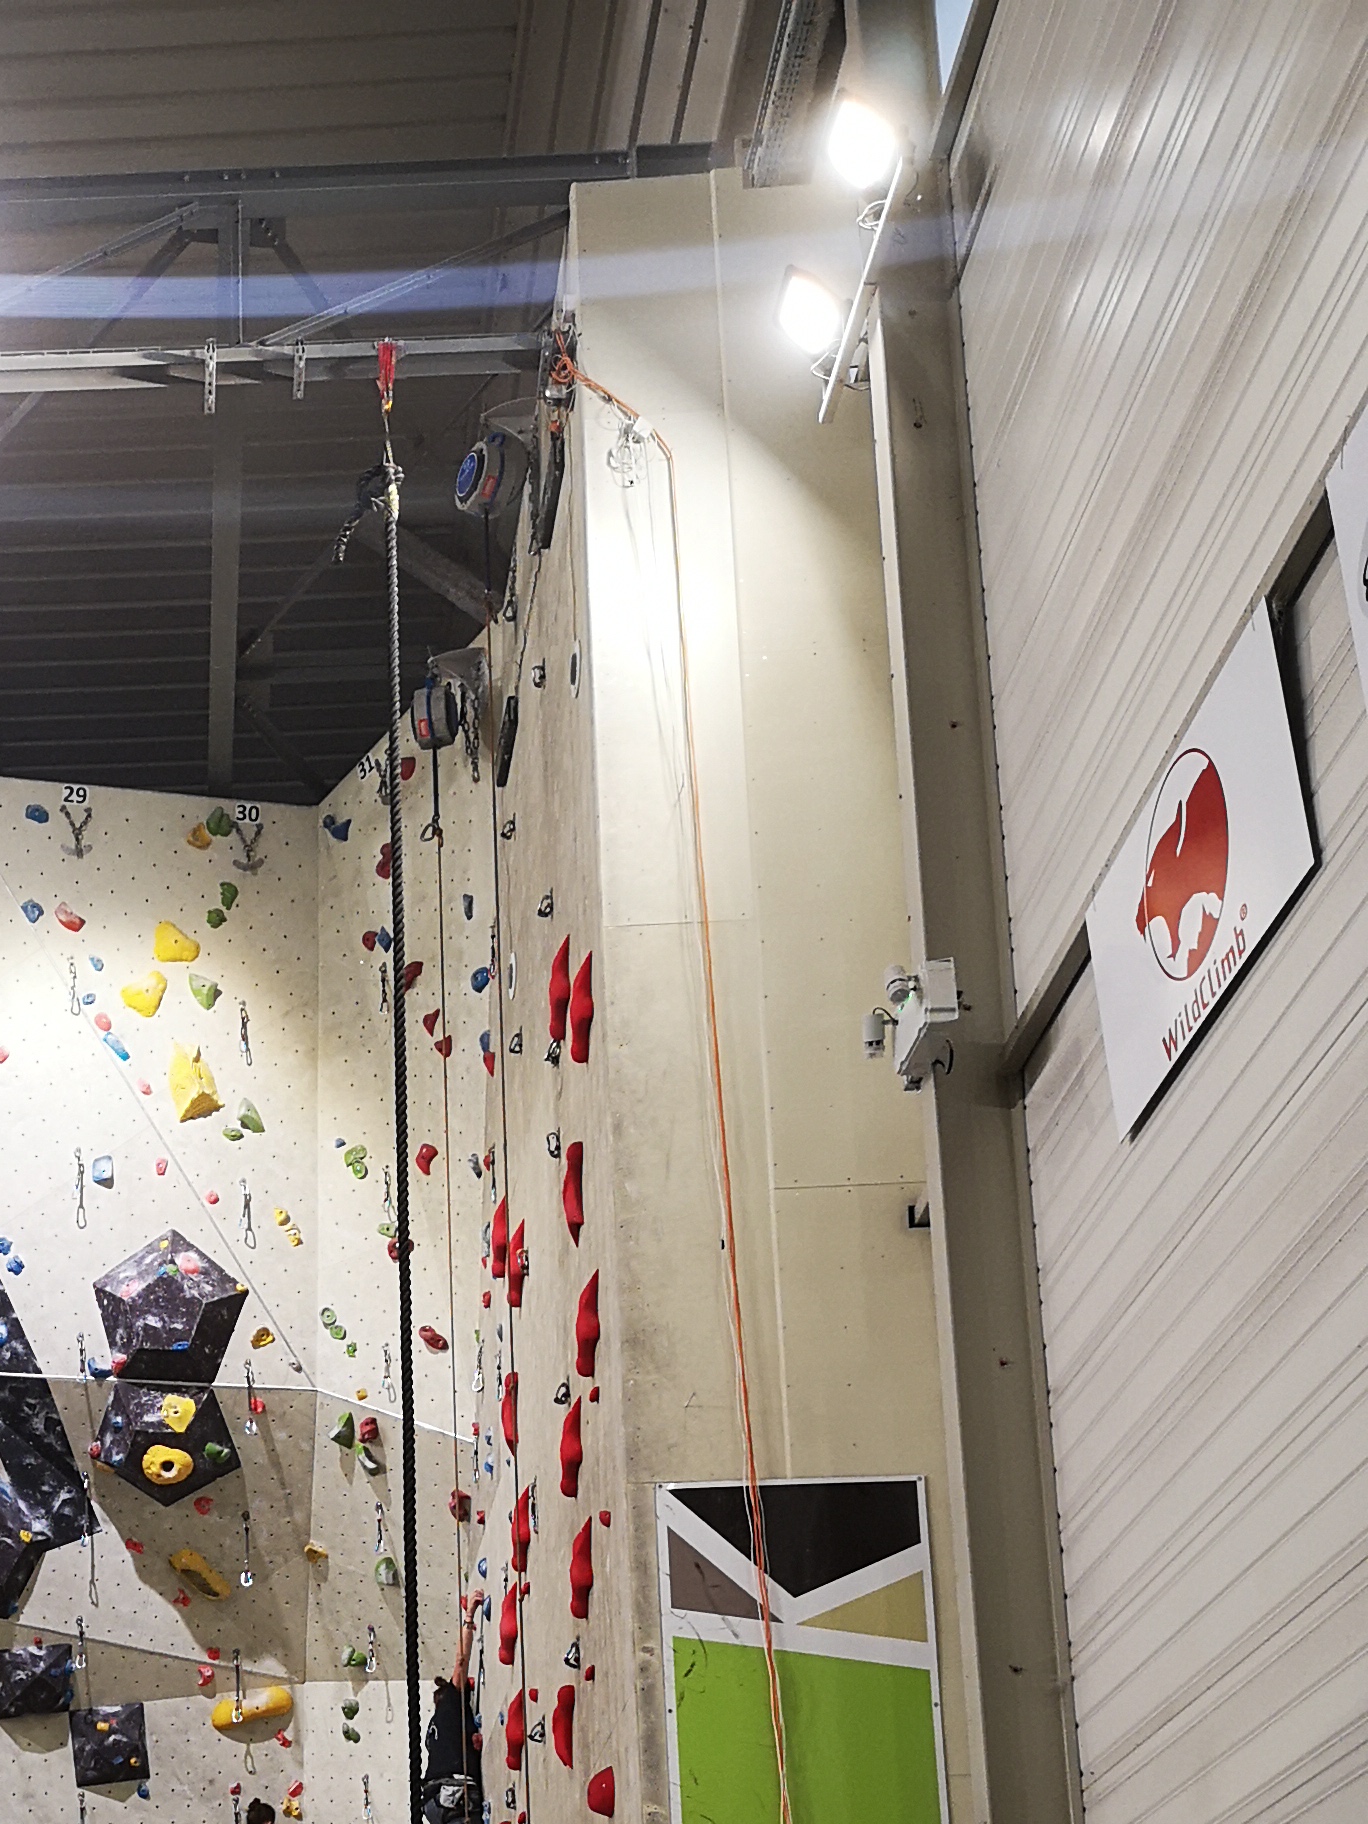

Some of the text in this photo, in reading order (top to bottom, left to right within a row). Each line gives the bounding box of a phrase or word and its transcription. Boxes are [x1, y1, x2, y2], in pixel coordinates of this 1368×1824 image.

[358, 754, 375, 780] 31
[62, 785, 88, 804] 29
[235, 804, 260, 822] 30
[1161, 926, 1246, 1061] WildClimb
